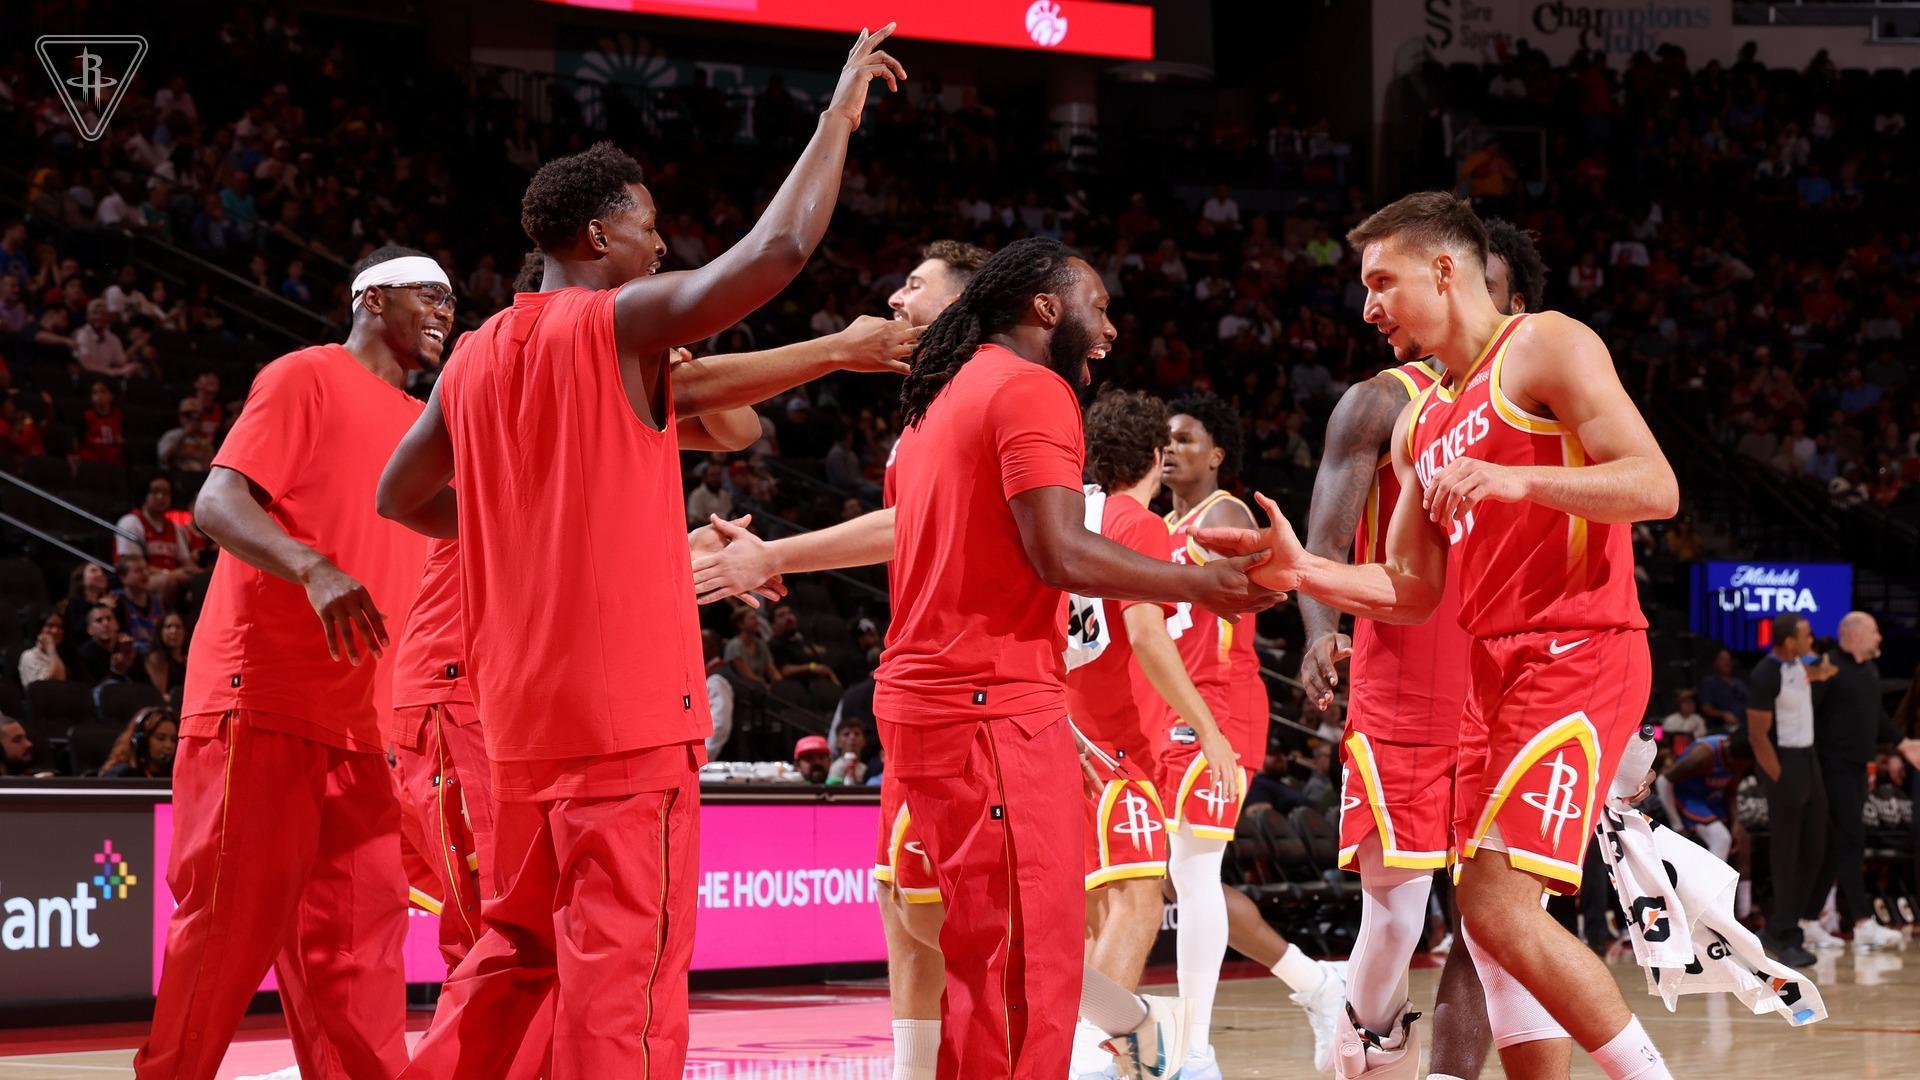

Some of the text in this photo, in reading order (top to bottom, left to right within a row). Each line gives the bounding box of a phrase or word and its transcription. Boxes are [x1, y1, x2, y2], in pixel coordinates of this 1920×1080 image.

[1532, 1, 1712, 34] Champions
[1718, 586, 1818, 613] ULTRA
[698, 870, 730, 909] HE
[733, 867, 863, 908] HOUSTON
[0, 881, 101, 951] ant
